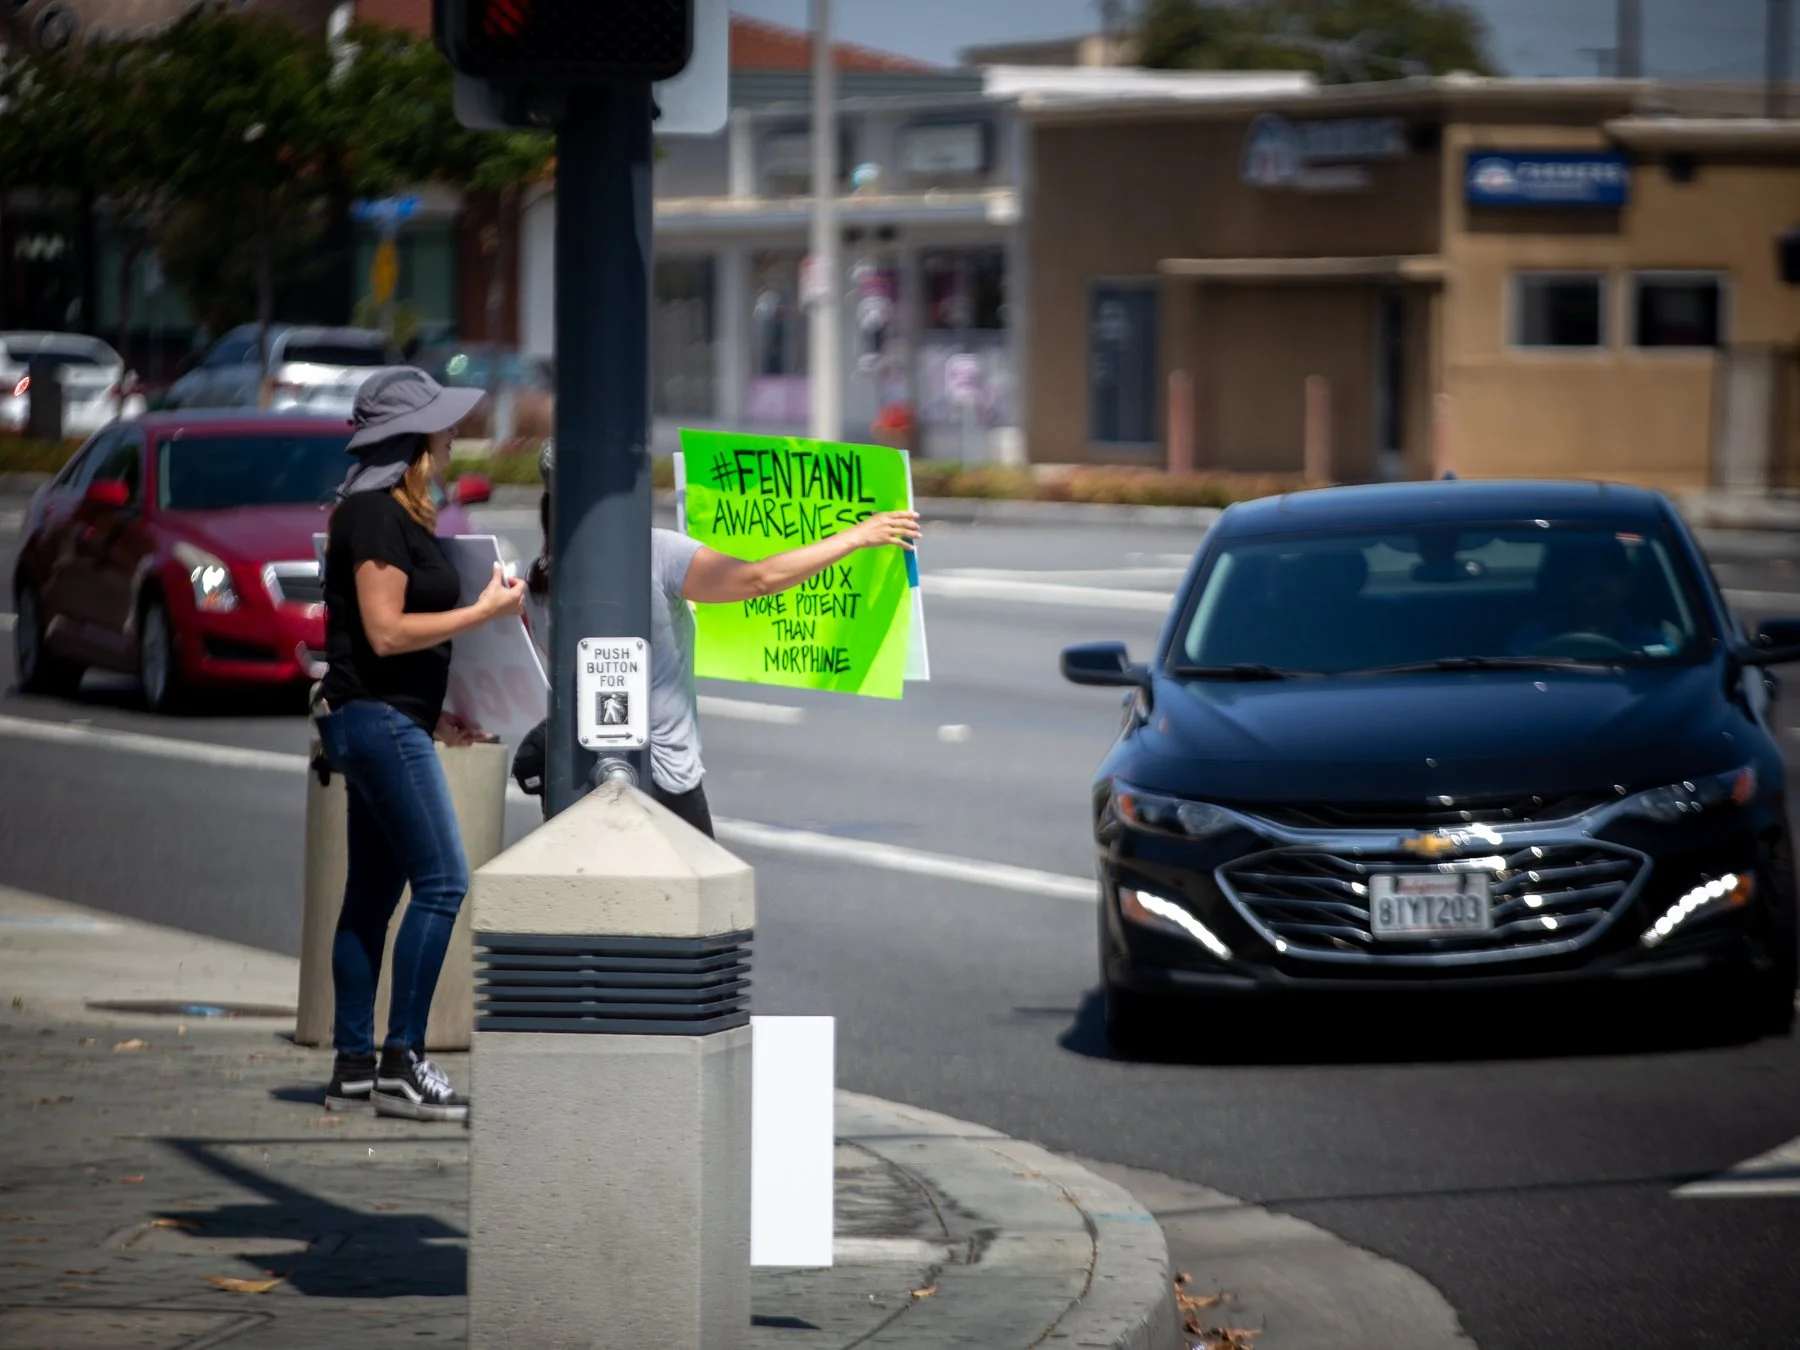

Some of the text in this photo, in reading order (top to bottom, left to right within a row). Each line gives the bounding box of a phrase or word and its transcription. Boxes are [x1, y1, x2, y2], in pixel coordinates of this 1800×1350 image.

[710, 449, 876, 503] #FENTANYL
[743, 593, 861, 619] MORE POTENT
[771, 619, 815, 641] THAN
[594, 648, 629, 660] PUSH
[763, 644, 851, 674] MORPHINE
[586, 661, 638, 673] BUTTON
[600, 675, 625, 687] FOR
